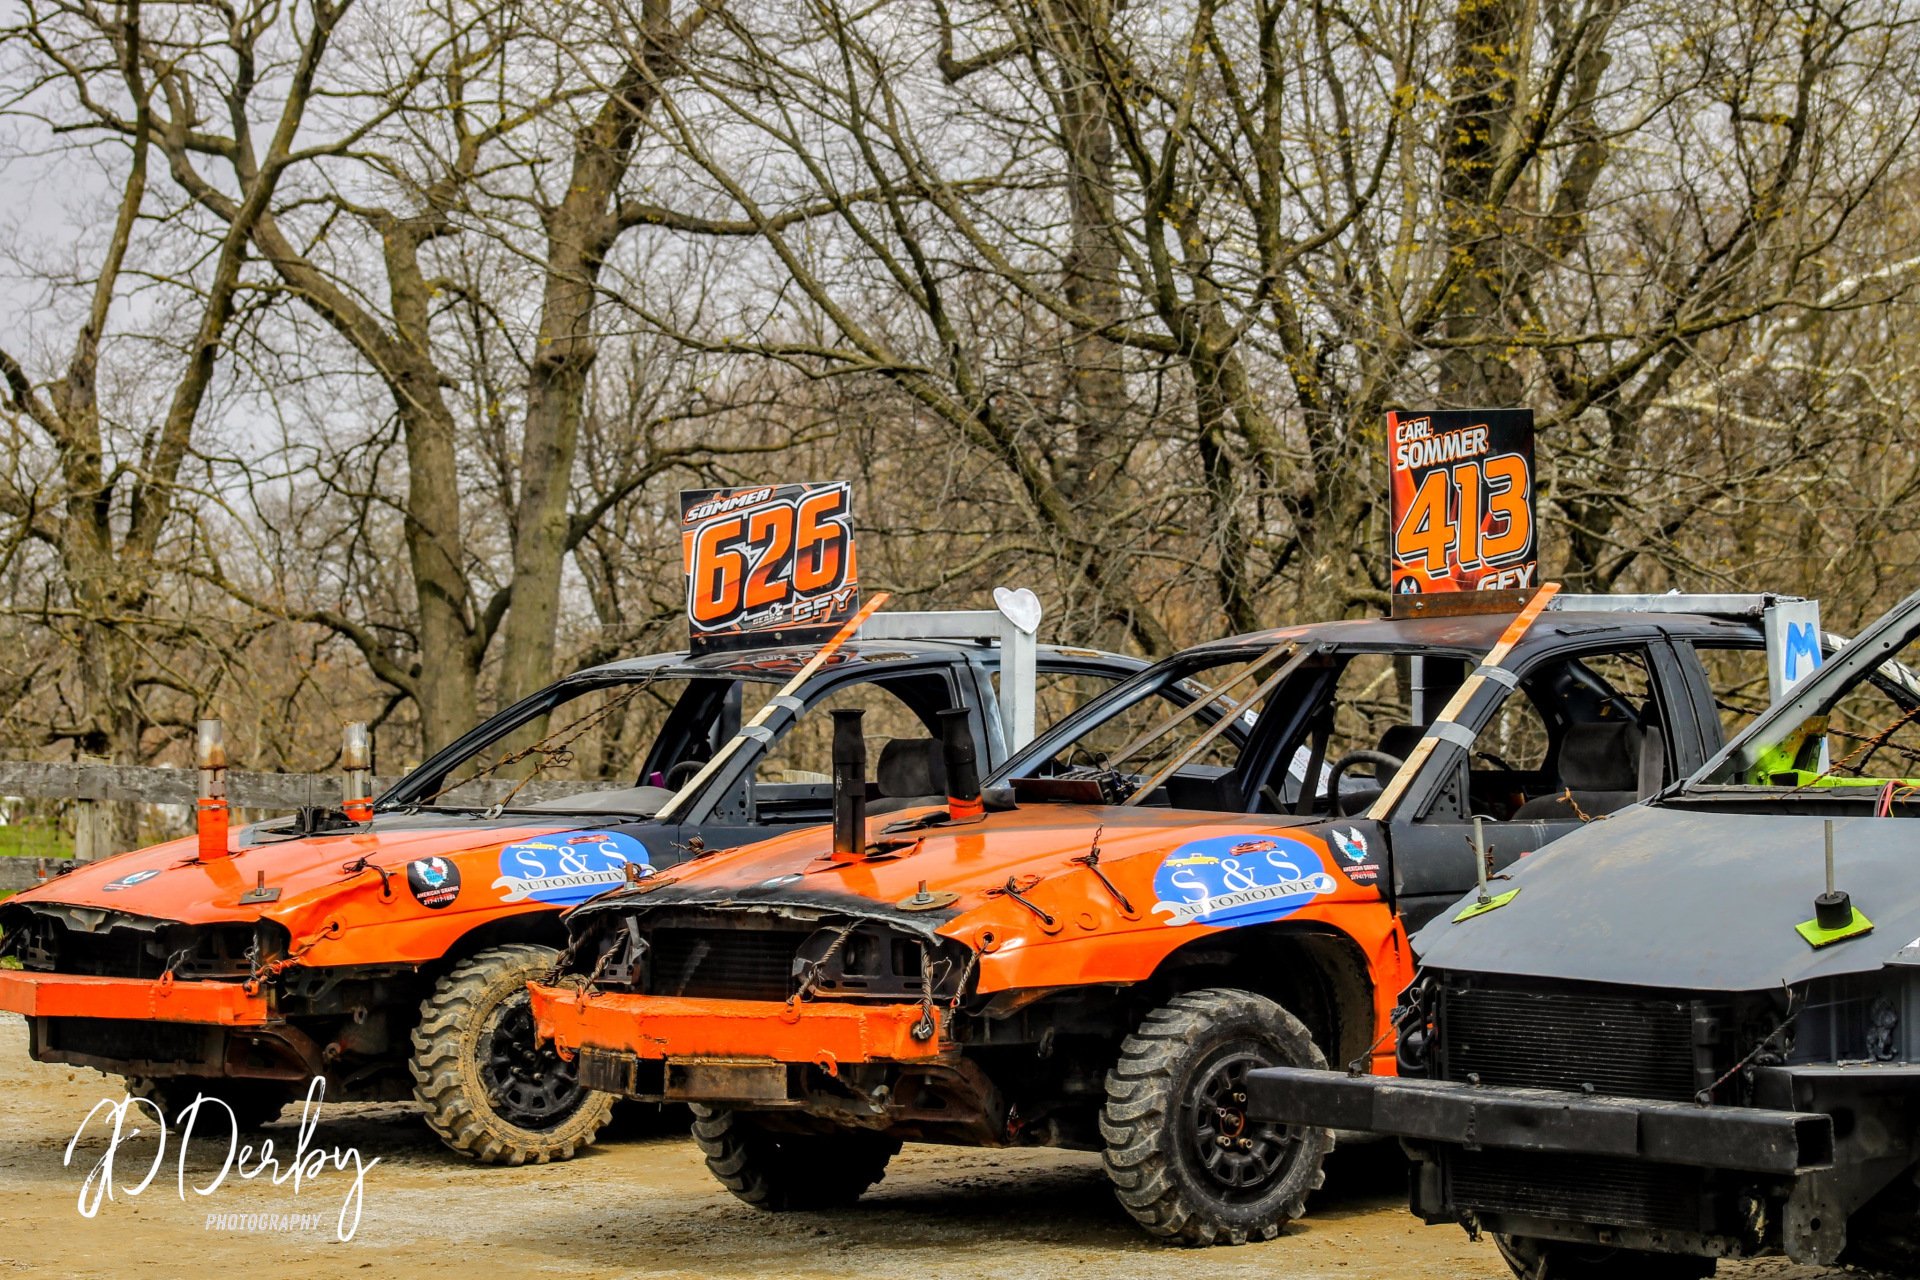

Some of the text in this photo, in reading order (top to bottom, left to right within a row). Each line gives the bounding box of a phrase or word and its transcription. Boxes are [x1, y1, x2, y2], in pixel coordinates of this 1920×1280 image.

[1396, 420, 1431, 443] CARL
[1397, 427, 1487, 471] SOMMER
[686, 488, 772, 522] SOMMER
[1397, 454, 1531, 578] 413
[693, 490, 842, 623] 626
[794, 591, 851, 621] GFY
[515, 850, 546, 880] S
[558, 846, 594, 875] &
[1170, 850, 1302, 904] S & S
[516, 872, 627, 892] AUTOMOTIV
[1178, 880, 1317, 917] AUTOMOTIVE
